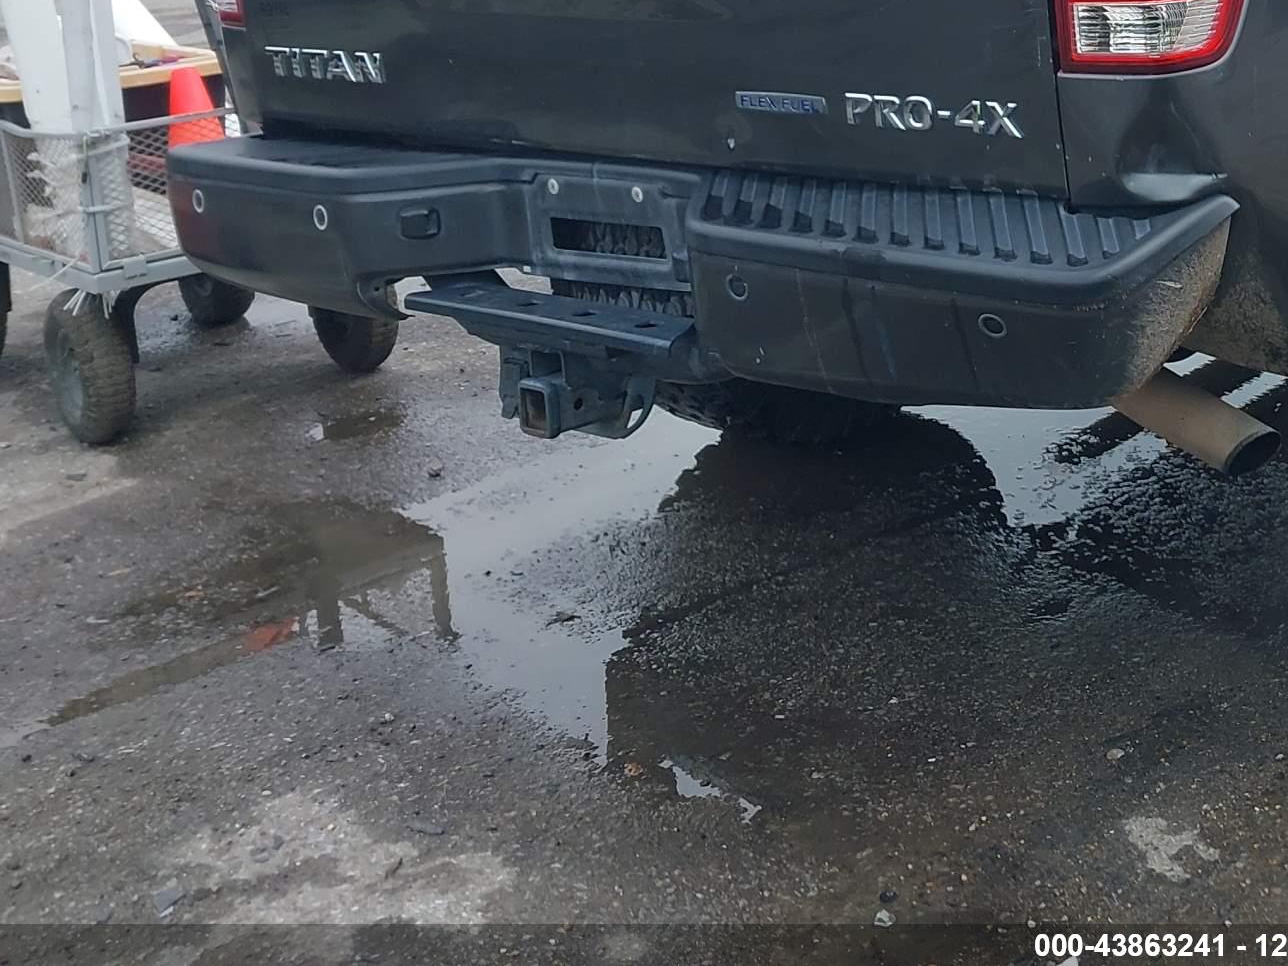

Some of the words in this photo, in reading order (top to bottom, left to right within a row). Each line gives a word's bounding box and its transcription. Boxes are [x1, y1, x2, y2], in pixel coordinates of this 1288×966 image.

[264, 45, 386, 84] TITAN
[740, 95, 778, 111] FLEX
[781, 98, 821, 114] FUEL
[844, 92, 1024, 139] PRO-4X
